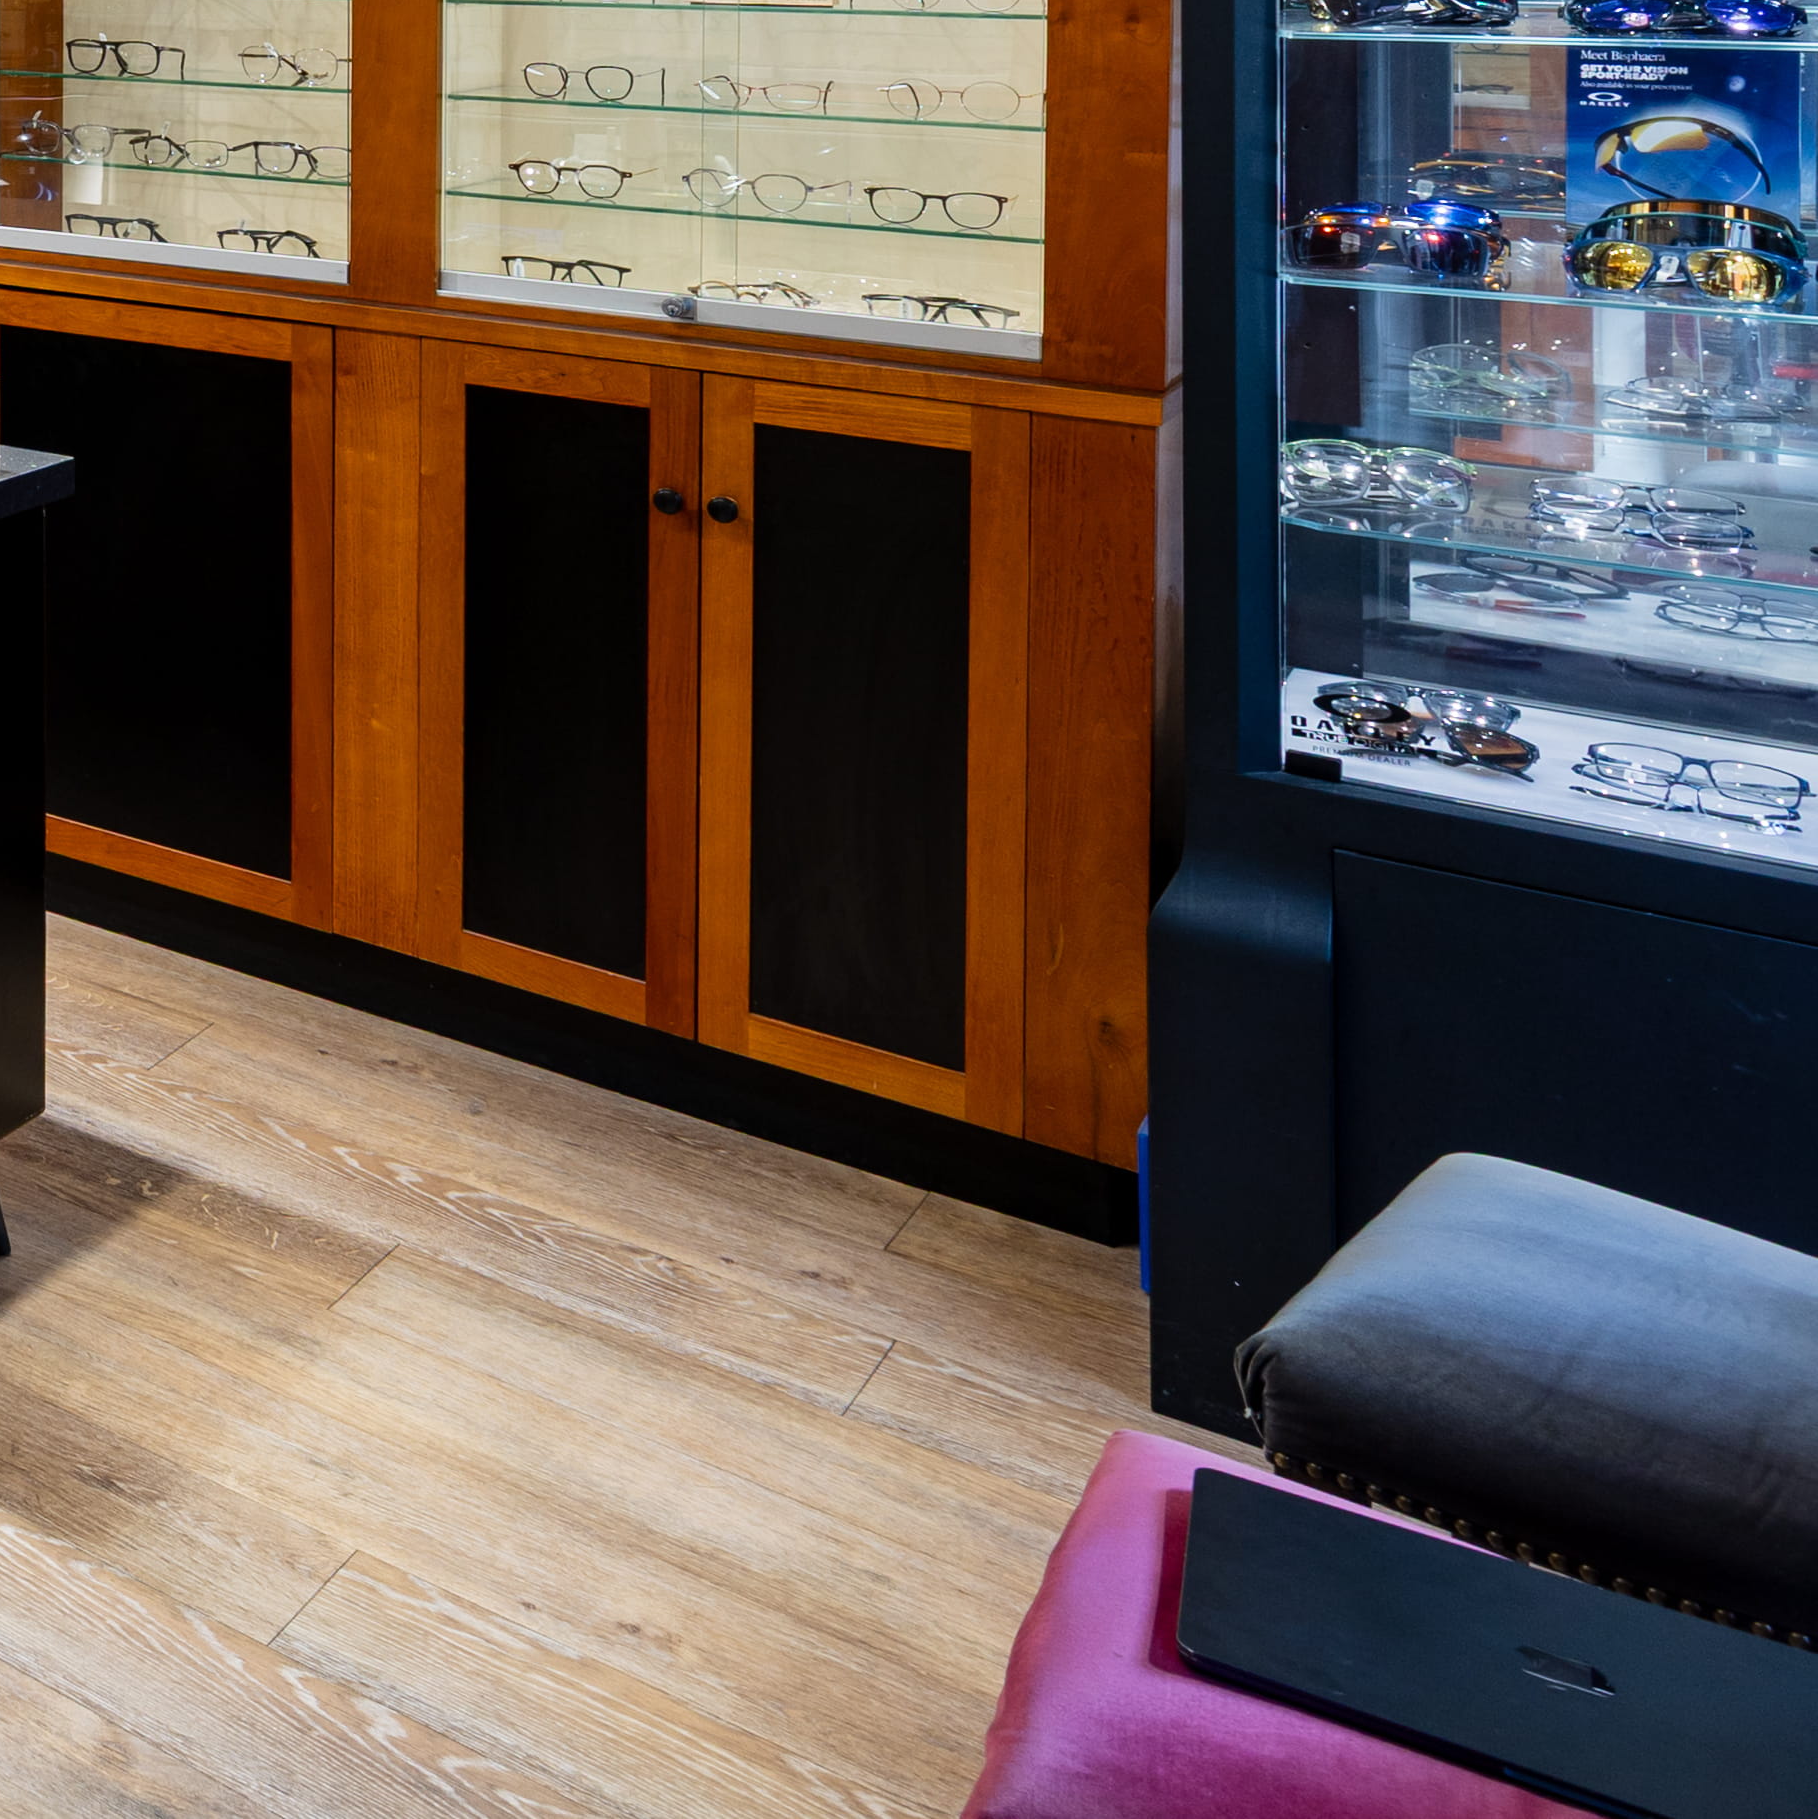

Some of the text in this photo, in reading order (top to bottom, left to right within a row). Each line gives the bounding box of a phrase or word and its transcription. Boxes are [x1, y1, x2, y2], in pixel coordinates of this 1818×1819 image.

[1580, 49, 1609, 61] Meet
[1580, 63, 1689, 75] GET YOUR VISION
[1367, 754, 1412, 767] DEALER
